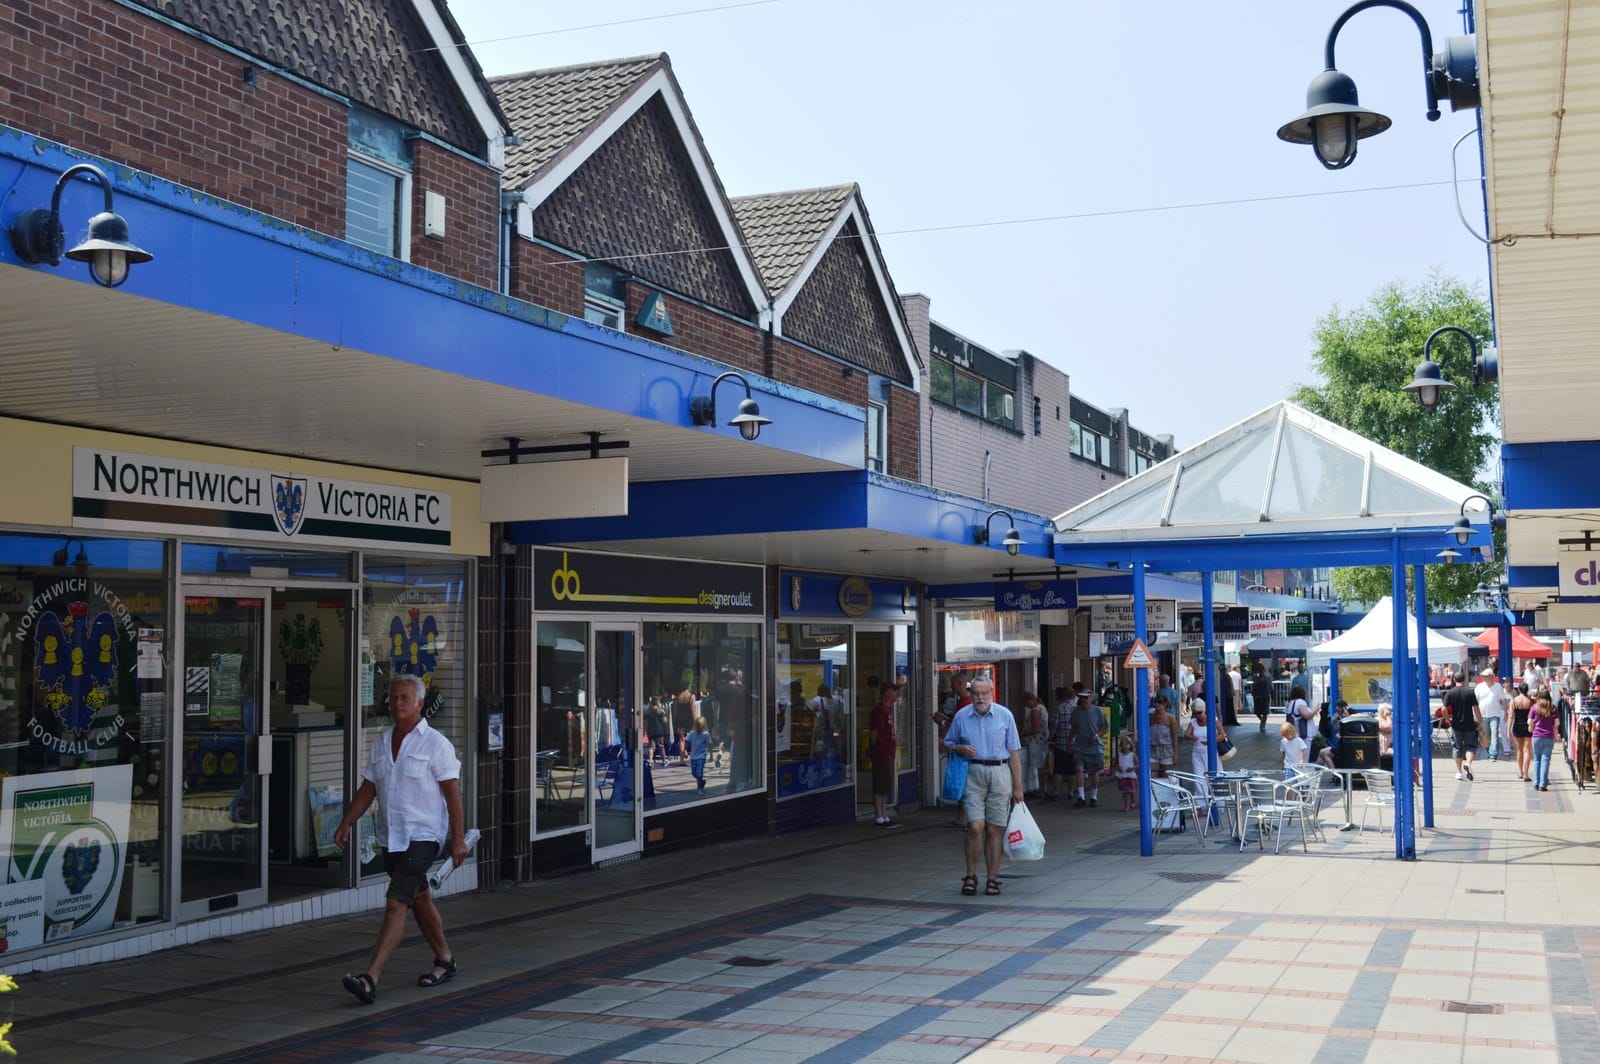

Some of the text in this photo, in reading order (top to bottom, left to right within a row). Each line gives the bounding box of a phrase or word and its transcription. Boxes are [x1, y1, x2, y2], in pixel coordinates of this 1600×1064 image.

[93, 453, 440, 526] NORTHWICH VICTORIA FC
[1003, 590, 1066, 610] Coffee Bar
[15, 578, 137, 643] NORTHWICH VICTORIA
[1249, 611, 1281, 622] SAGENT
[1286, 616, 1309, 624] AVERS
[425, 693, 444, 719] CLUB
[26, 716, 93, 755] FOOTBALL
[95, 713, 125, 746] CLUB
[24, 795, 88, 813] NORTHWICH
[23, 813, 72, 829] VICTORIA
[4, 894, 42, 907] collection
[18, 910, 41, 921] point.
